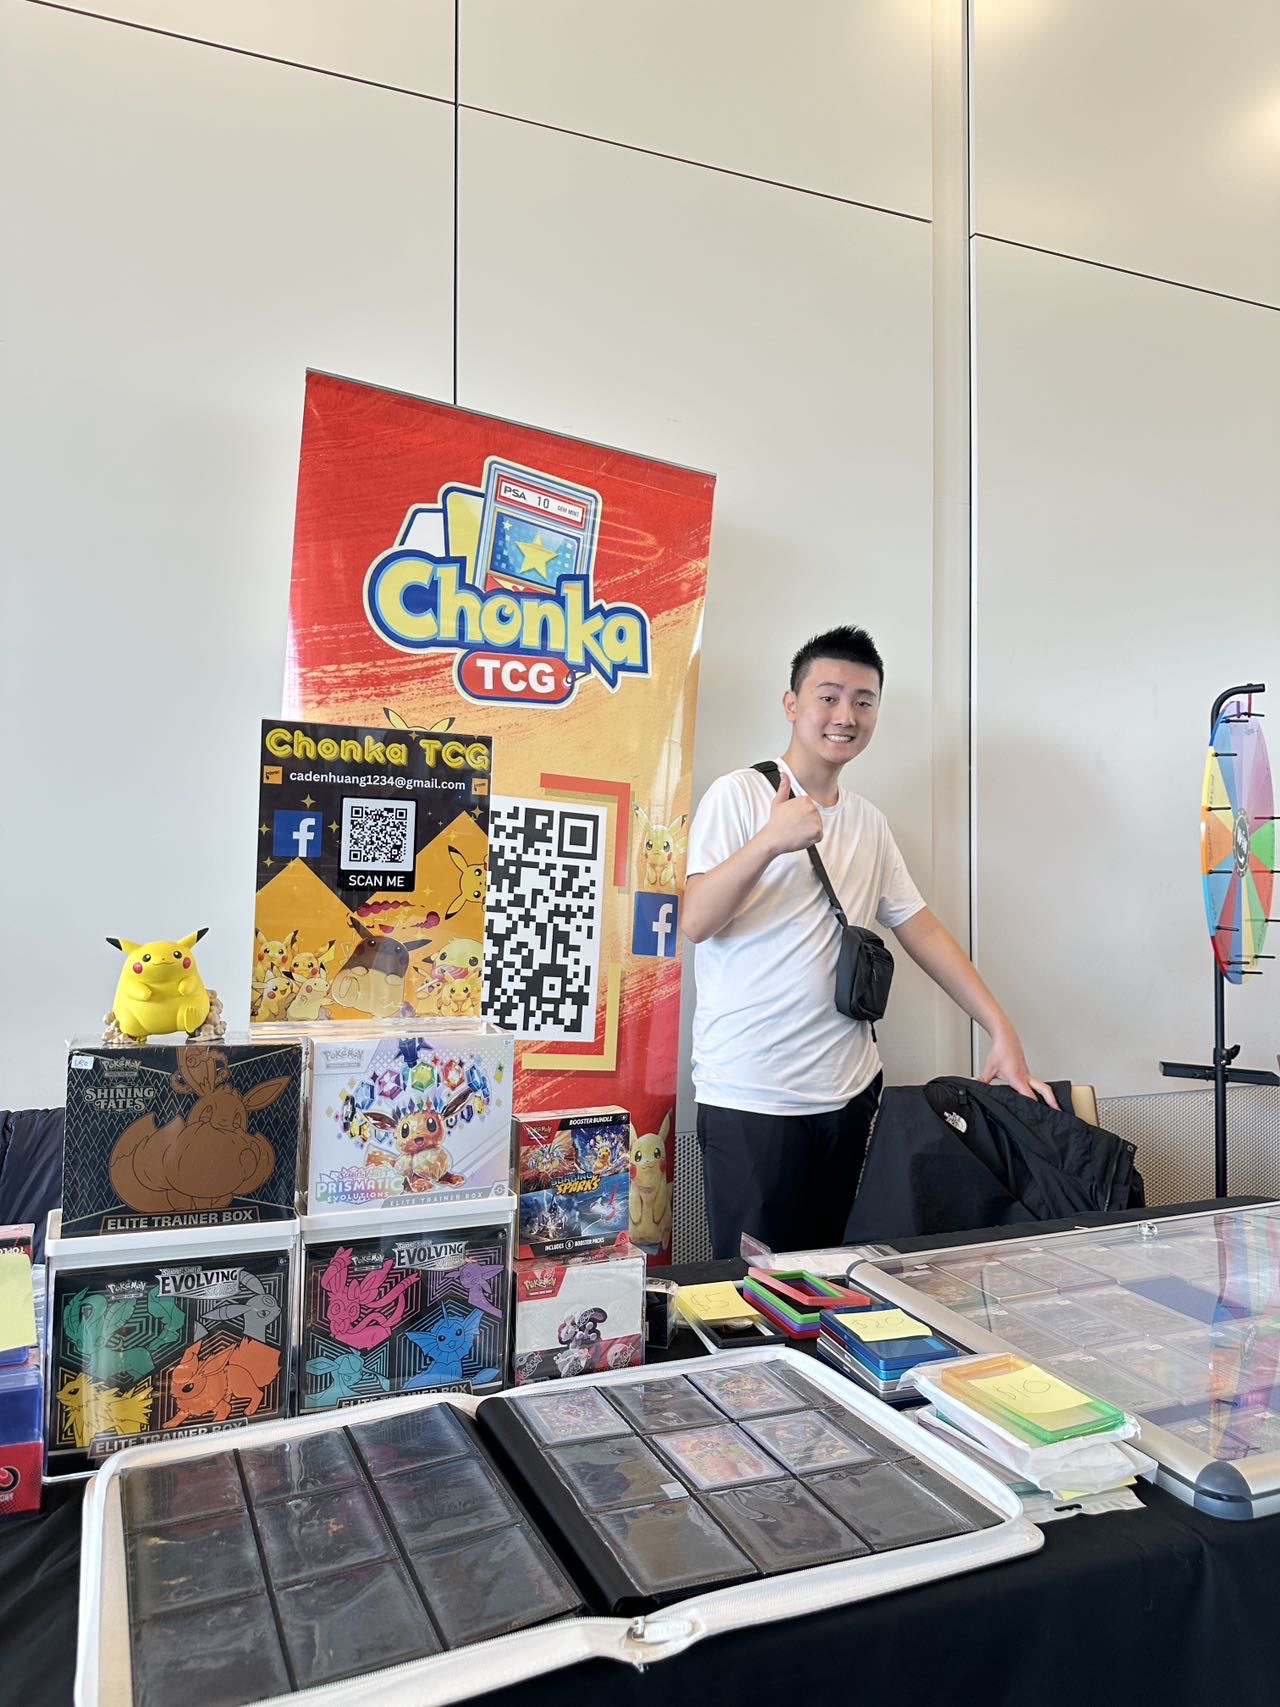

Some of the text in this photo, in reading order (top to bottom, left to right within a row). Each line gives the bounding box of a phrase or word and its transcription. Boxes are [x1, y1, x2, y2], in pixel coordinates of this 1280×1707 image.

[503, 485, 527, 501] PSA
[537, 496, 550, 509] 10
[374, 558, 643, 680] Chonka
[475, 657, 556, 694] TCG
[265, 727, 491, 772] Chonka TCG
[289, 771, 466, 790] cadenhuang1234@gmail.com
[348, 874, 405, 887] SCAN ME
[84, 1087, 156, 1102] SHINING
[95, 1098, 146, 1112] FATES
[315, 1176, 403, 1200] PRISMATIC
[556, 1174, 601, 1195] SPARKS
[327, 1191, 389, 1203] EVOLUTIONS
[390, 1198, 415, 1207] ELITE
[421, 1195, 460, 1203] TRAINER
[107, 1210, 253, 1230] ELITE TRAINER BOX
[397, 1243, 463, 1266] EVOLVING
[160, 1269, 238, 1295] EVOLVING
[690, 1292, 730, 1312] $5
[851, 1316, 905, 1329] $20
